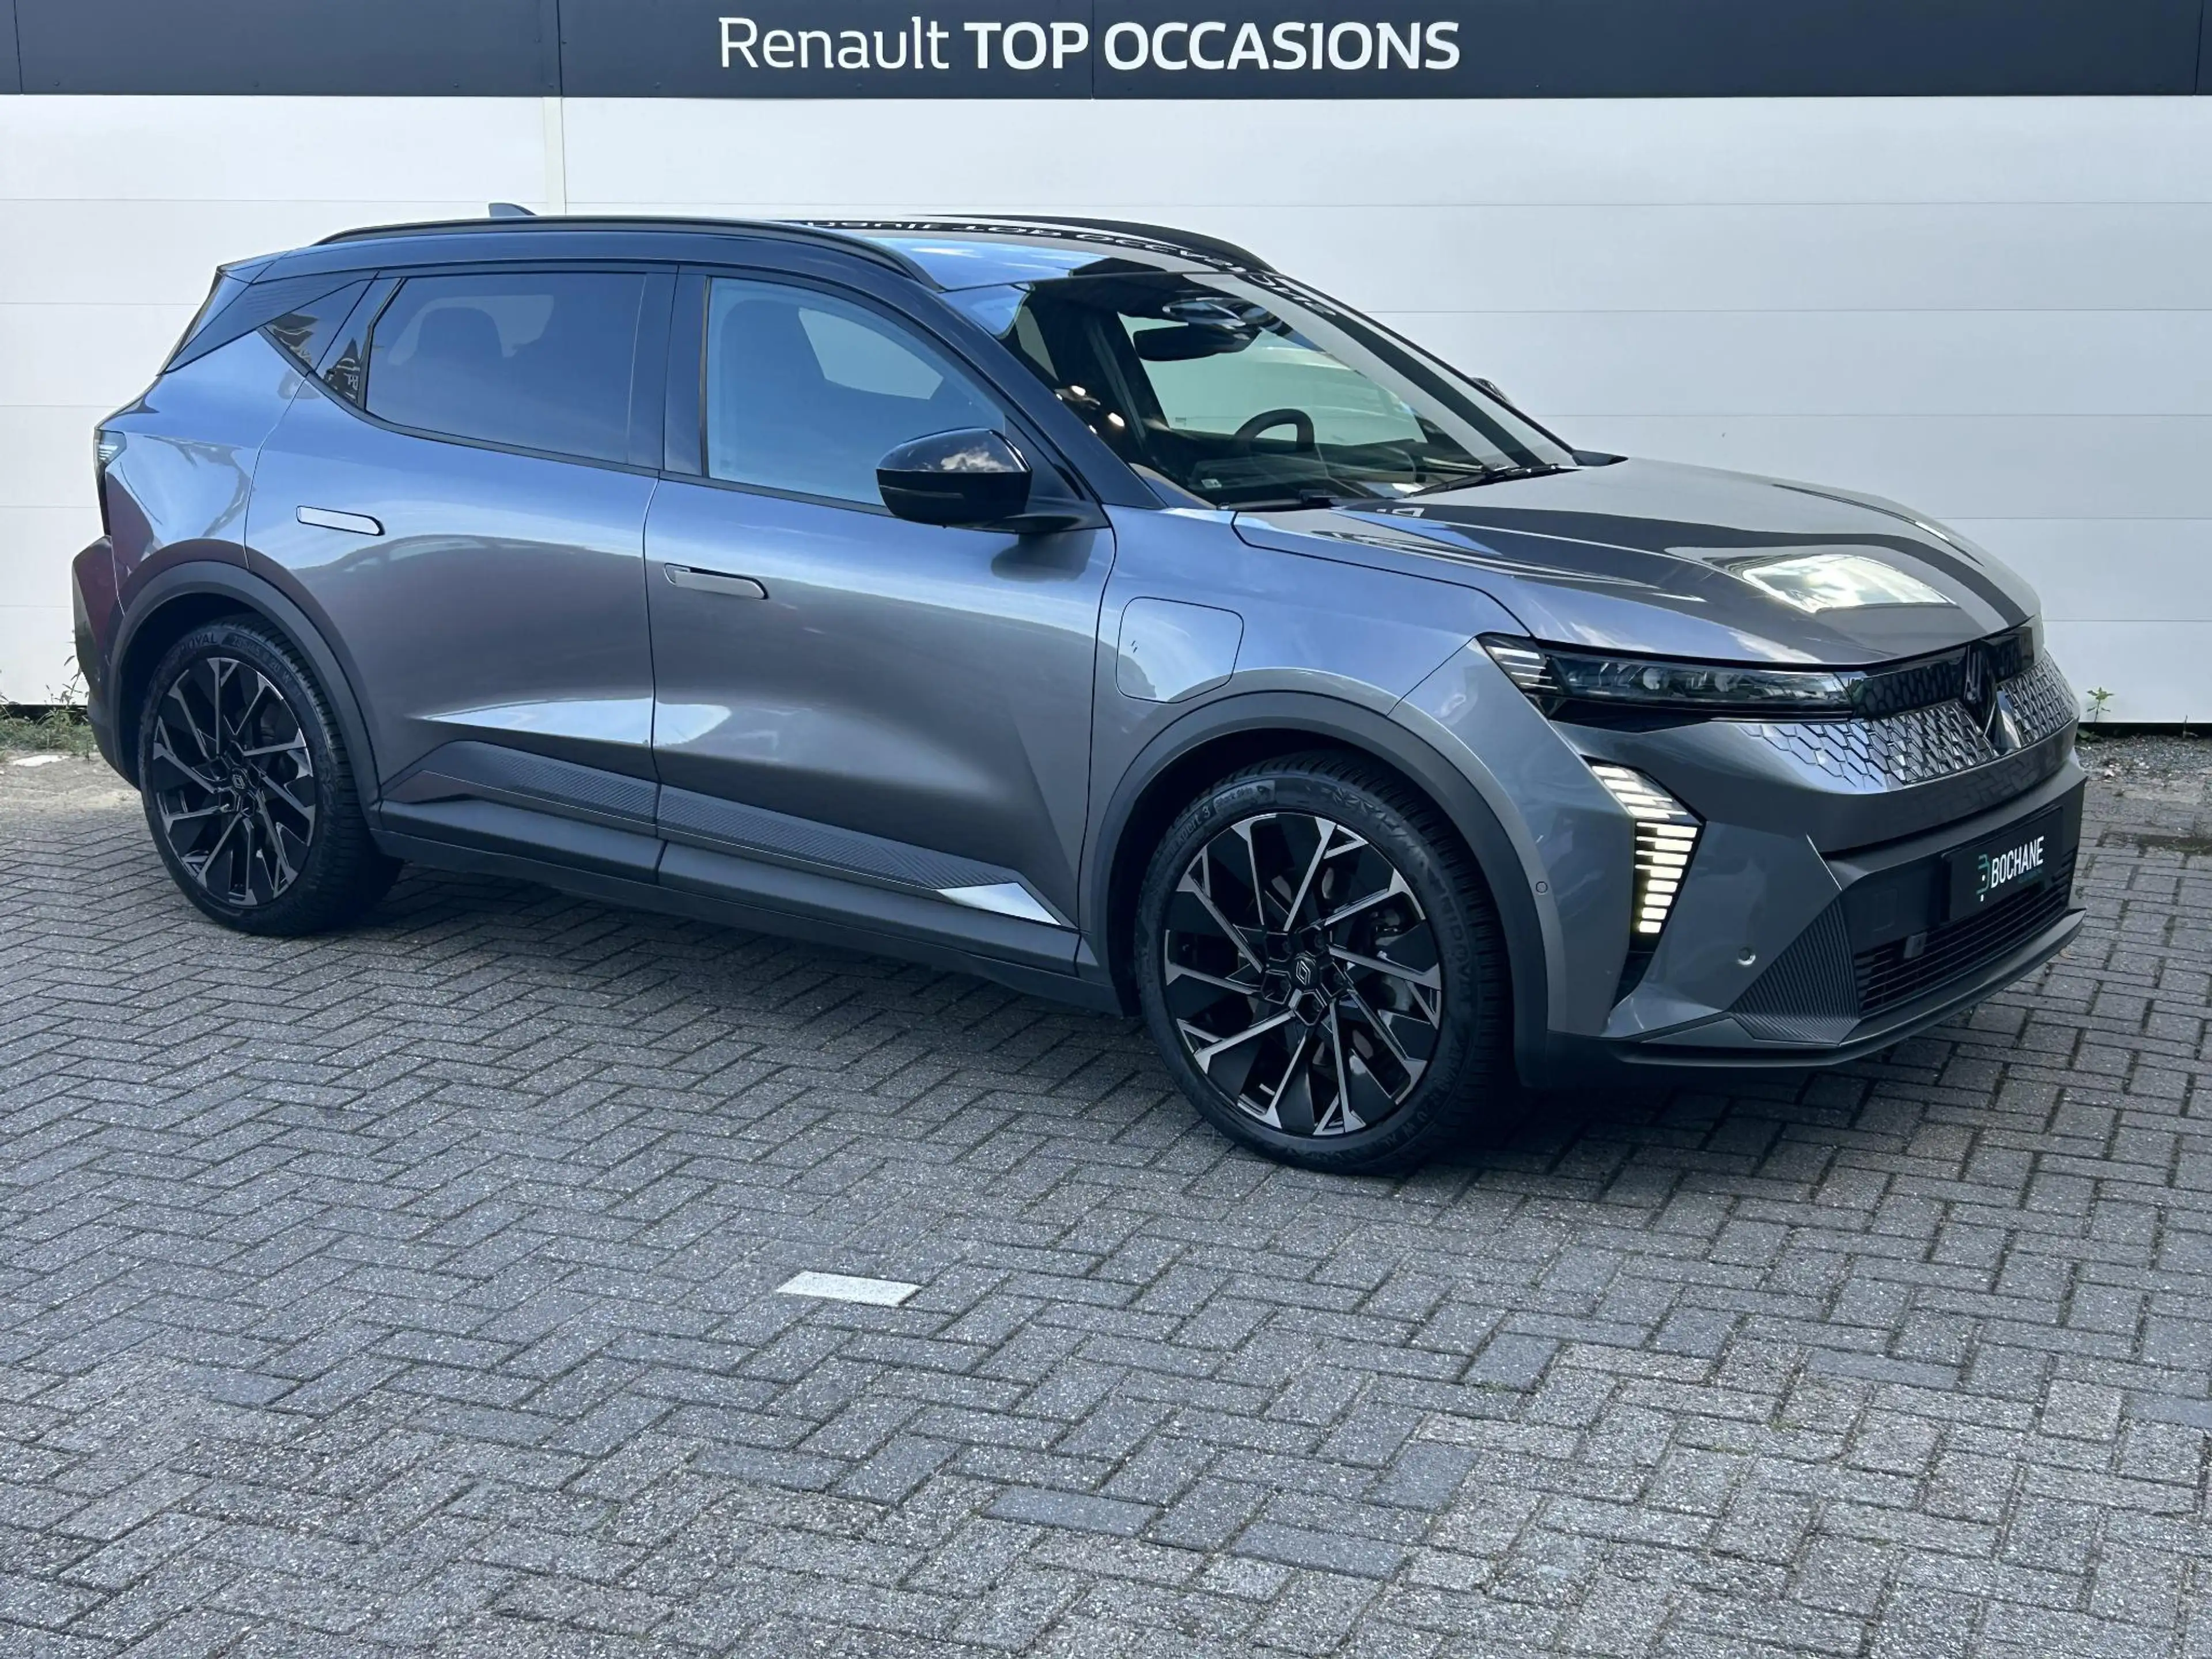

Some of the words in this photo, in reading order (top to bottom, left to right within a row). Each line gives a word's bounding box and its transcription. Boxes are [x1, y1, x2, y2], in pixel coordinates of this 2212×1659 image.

[718, 16, 949, 69] Renault
[963, 21, 1089, 69] TOP
[1104, 21, 1460, 70] OCCASIONS
[1990, 835, 2044, 889] BOCHANE
